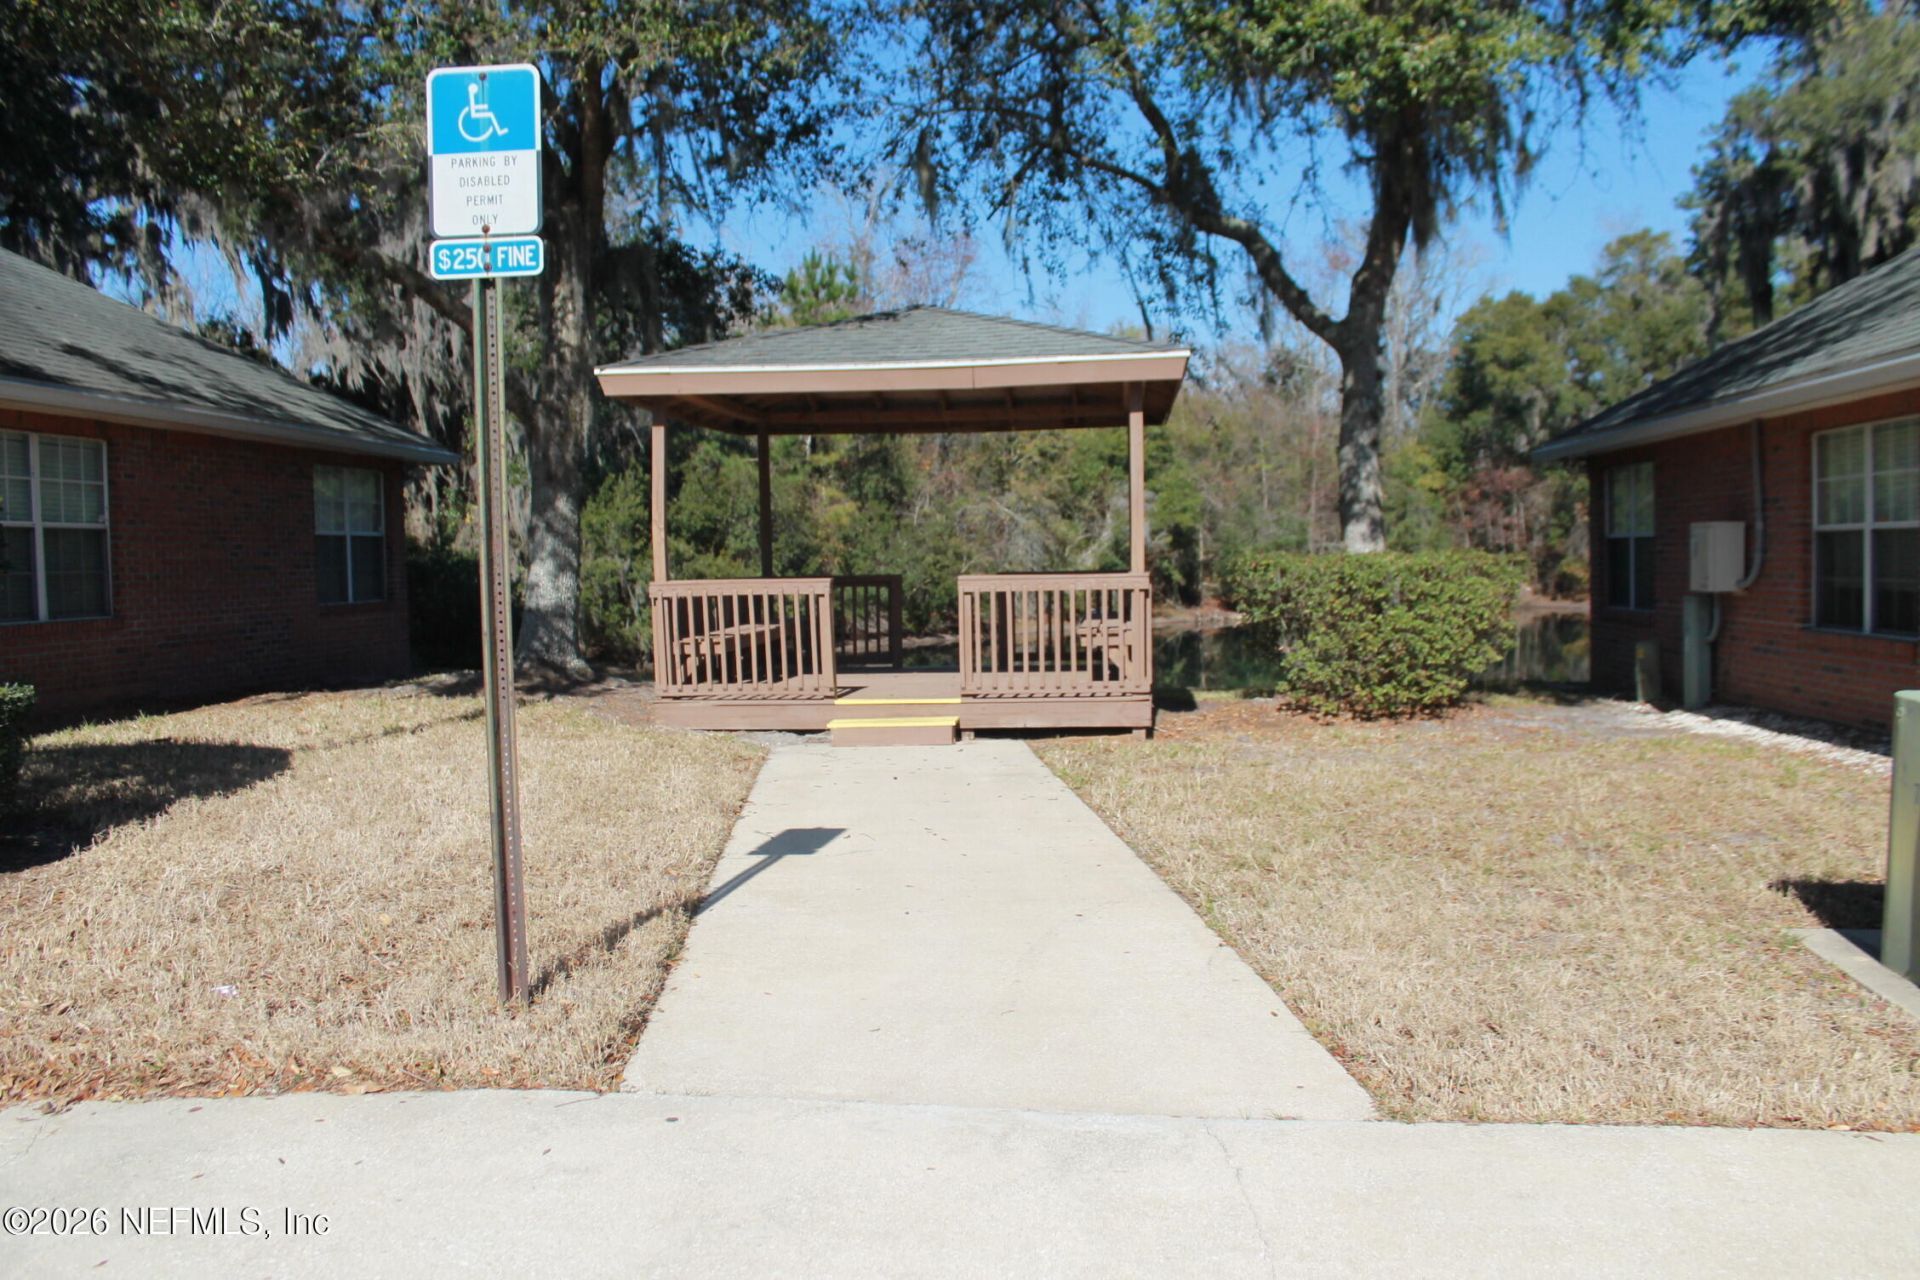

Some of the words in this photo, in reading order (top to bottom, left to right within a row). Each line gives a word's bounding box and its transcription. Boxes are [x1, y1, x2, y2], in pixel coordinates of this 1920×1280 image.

[451, 156, 496, 168] PARKING
[504, 155, 517, 167] BY
[459, 175, 510, 188] DISABLED
[466, 194, 503, 206] PERMIT
[472, 214, 498, 226] ONLY
[497, 245, 536, 268] FINE
